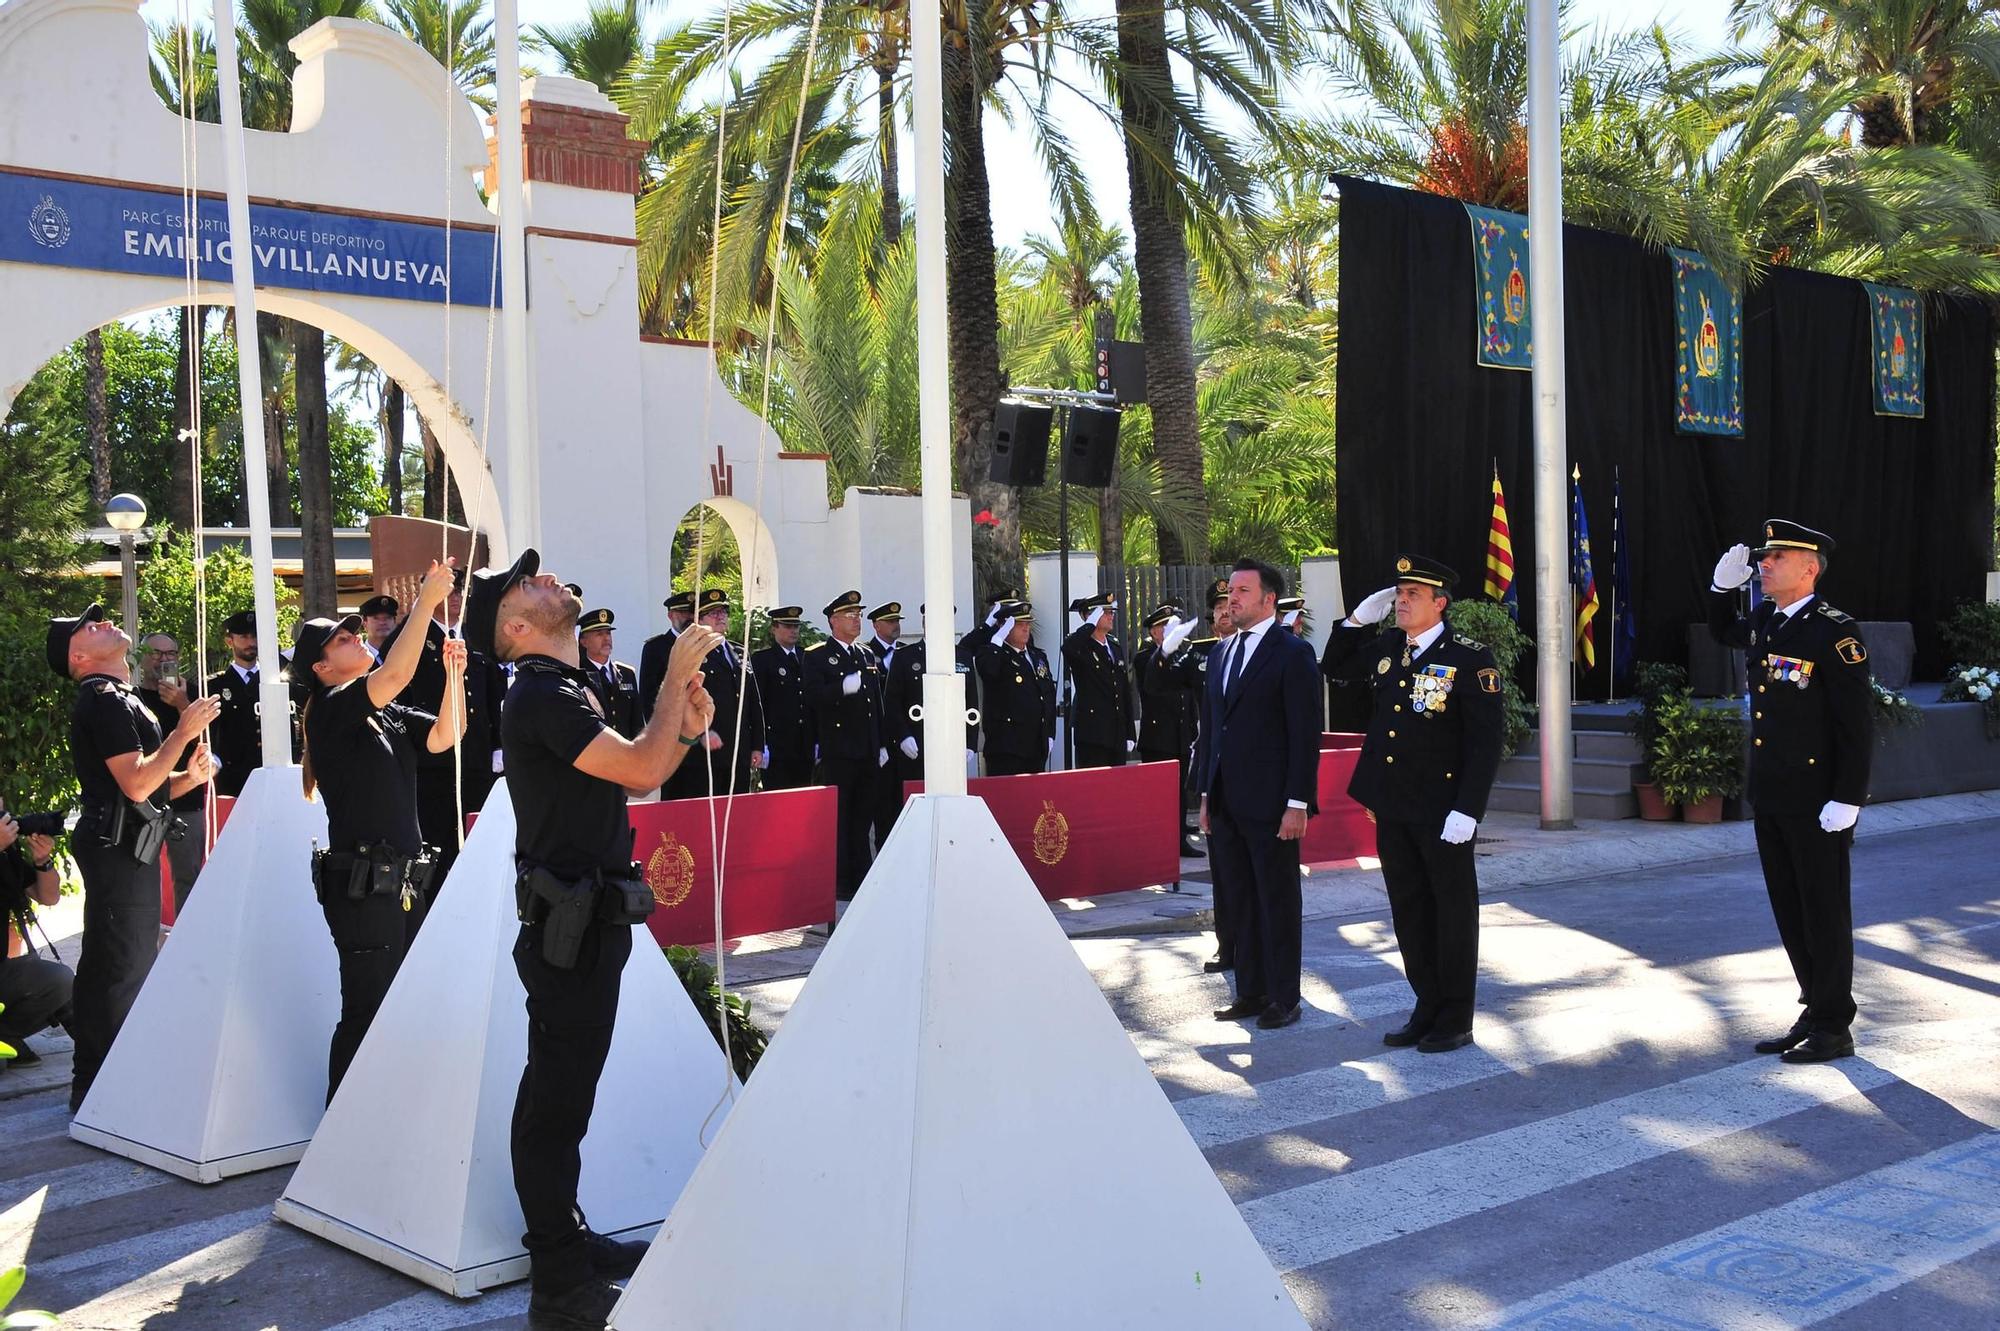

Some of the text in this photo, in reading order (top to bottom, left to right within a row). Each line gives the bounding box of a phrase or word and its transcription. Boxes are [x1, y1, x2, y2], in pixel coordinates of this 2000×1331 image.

[122, 209, 161, 226] PARC
[166, 214, 231, 234] ESRTIU
[252, 224, 307, 243] PARQUE
[311, 231, 385, 251] DEPORTIVO
[124, 229, 448, 287] EMILIO VILLANUEVA
